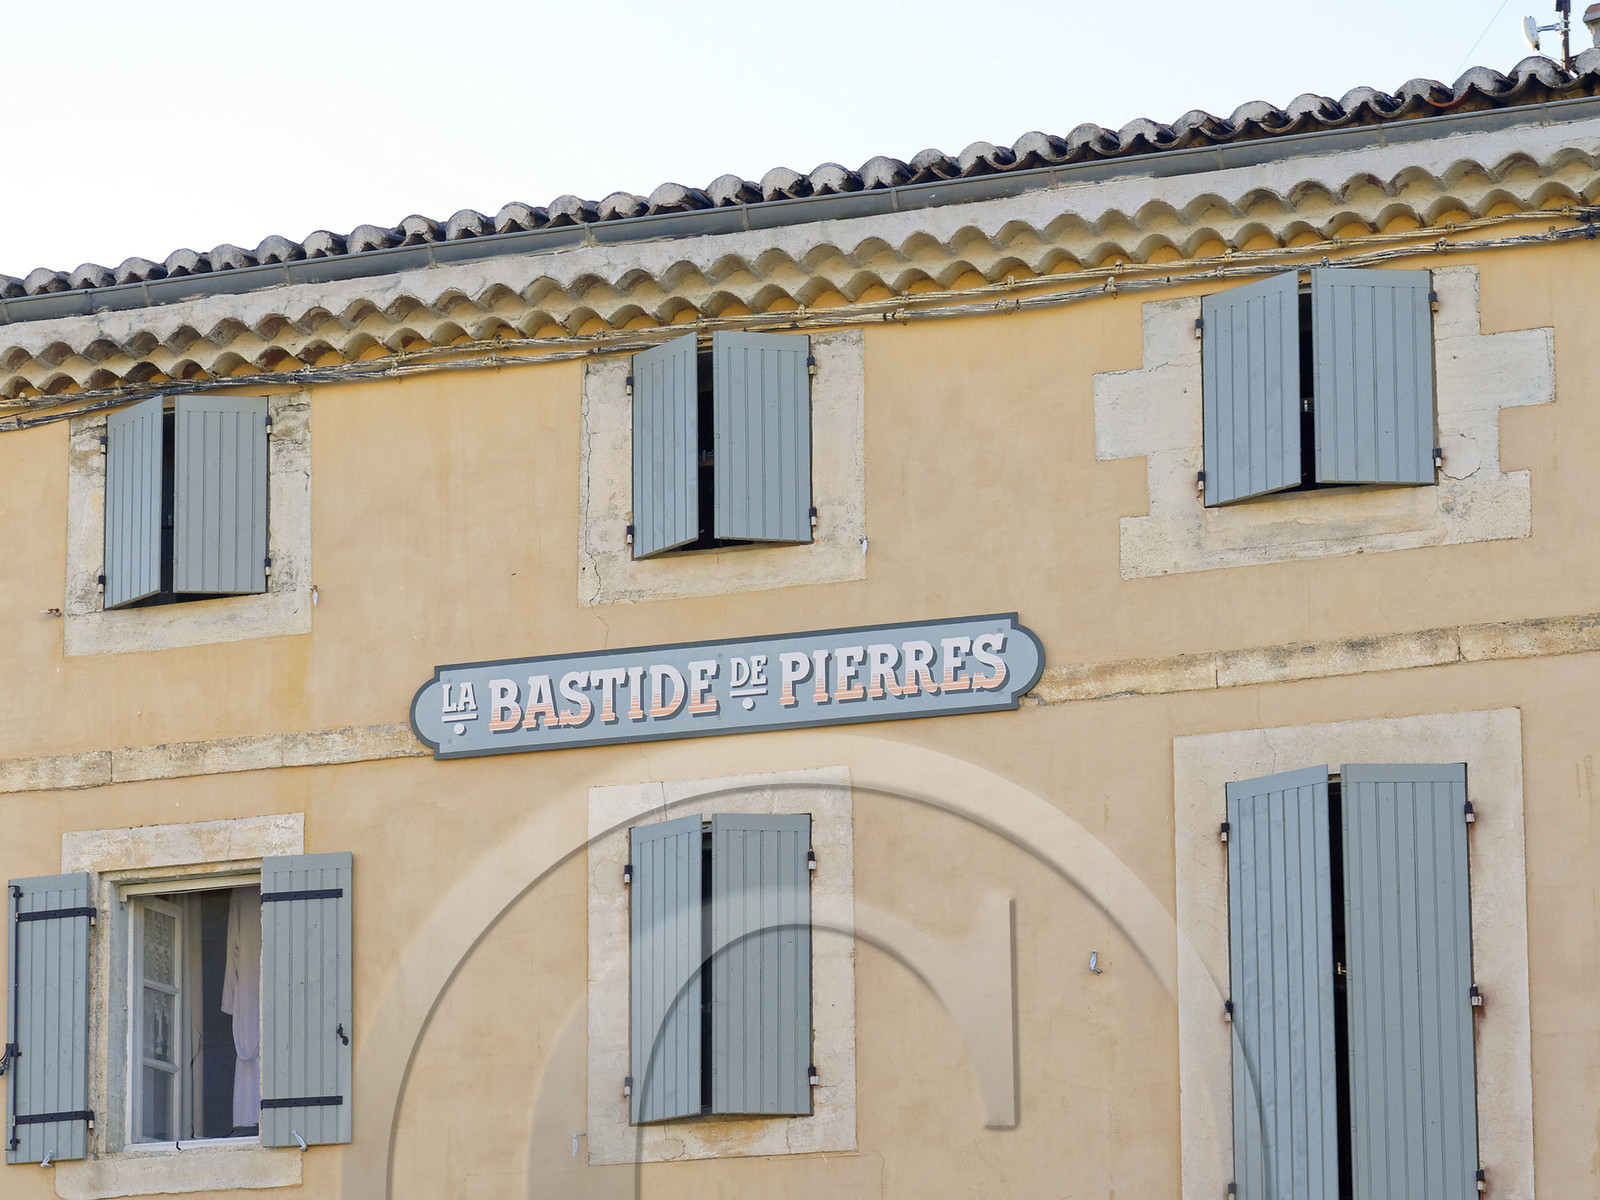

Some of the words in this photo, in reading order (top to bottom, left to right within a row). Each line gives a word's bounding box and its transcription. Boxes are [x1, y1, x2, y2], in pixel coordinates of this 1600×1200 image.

[442, 682, 478, 713] LA
[488, 660, 719, 732] BASTIDE
[729, 655, 767, 687] DE
[779, 633, 1007, 706] PIERRES
